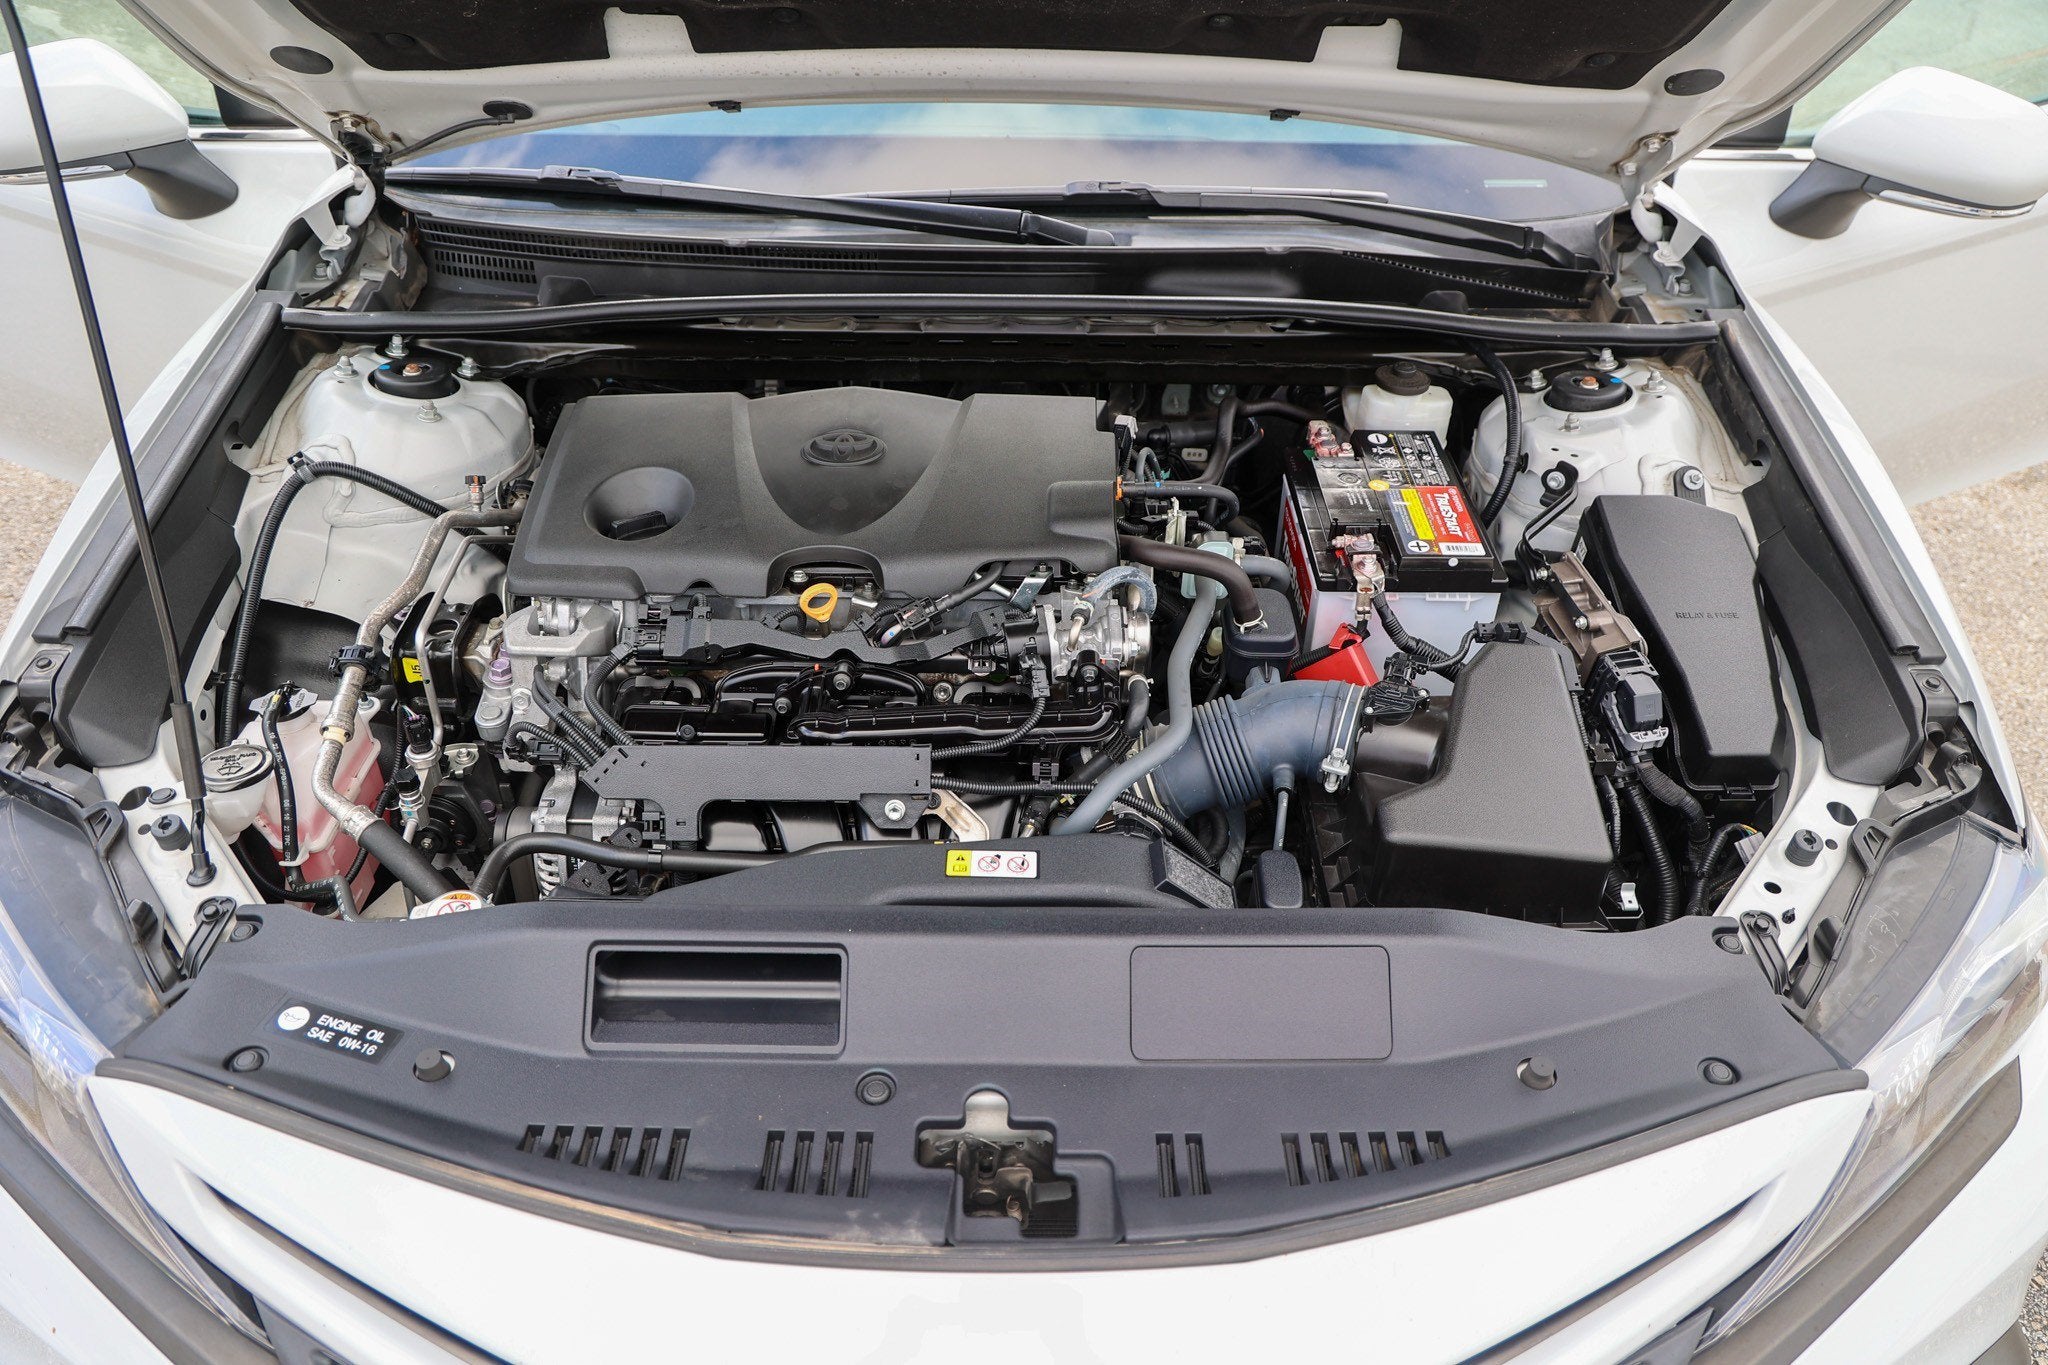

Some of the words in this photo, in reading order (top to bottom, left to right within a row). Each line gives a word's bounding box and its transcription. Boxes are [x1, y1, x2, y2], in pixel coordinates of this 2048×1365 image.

[1674, 611, 1704, 619] RELAY
[307, 1026, 336, 1042] SAE
[338, 1036, 378, 1056] 0W-16
[317, 1014, 363, 1036] ENGINE
[366, 1029, 385, 1043] OIL
